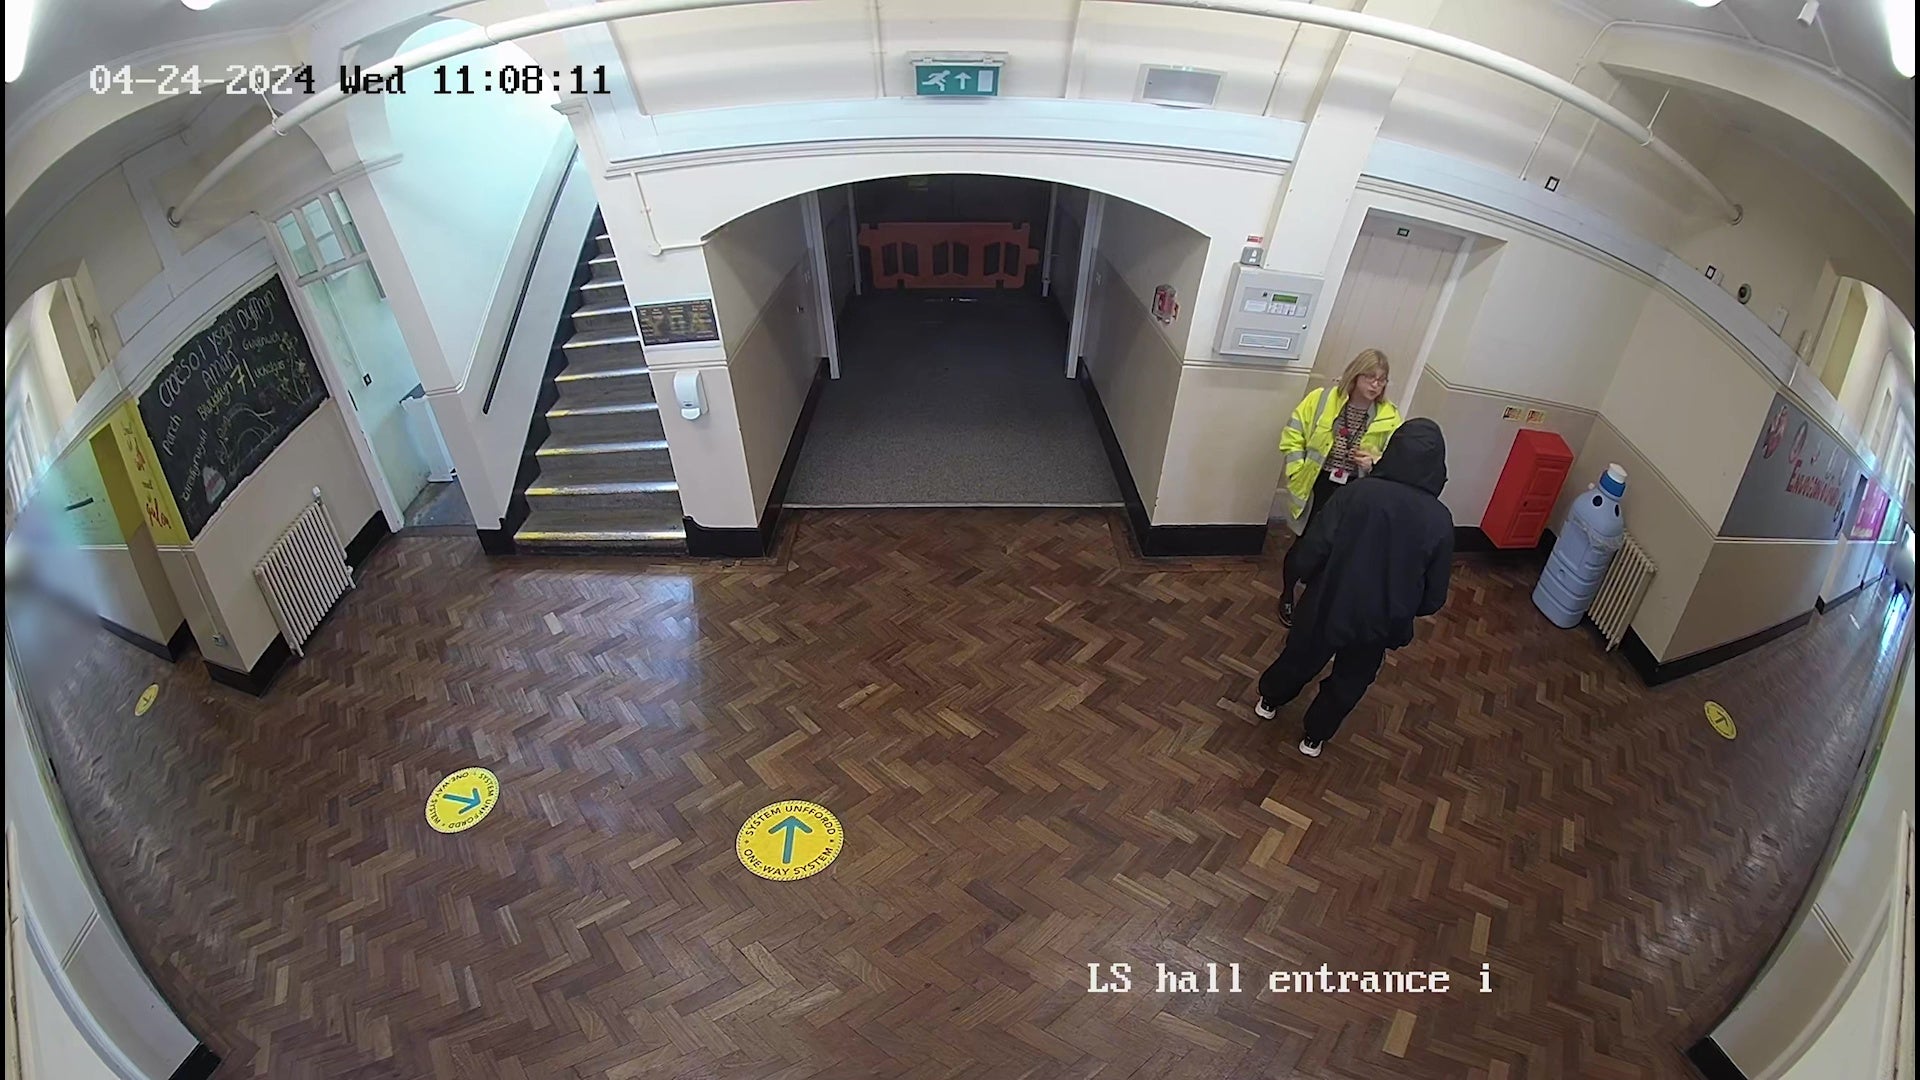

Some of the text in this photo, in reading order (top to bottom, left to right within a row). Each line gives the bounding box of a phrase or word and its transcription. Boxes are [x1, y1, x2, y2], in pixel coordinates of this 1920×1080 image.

[745, 805, 836, 837] SYSTEM UNFFORDD
[793, 847, 834, 875] SYSTEM
